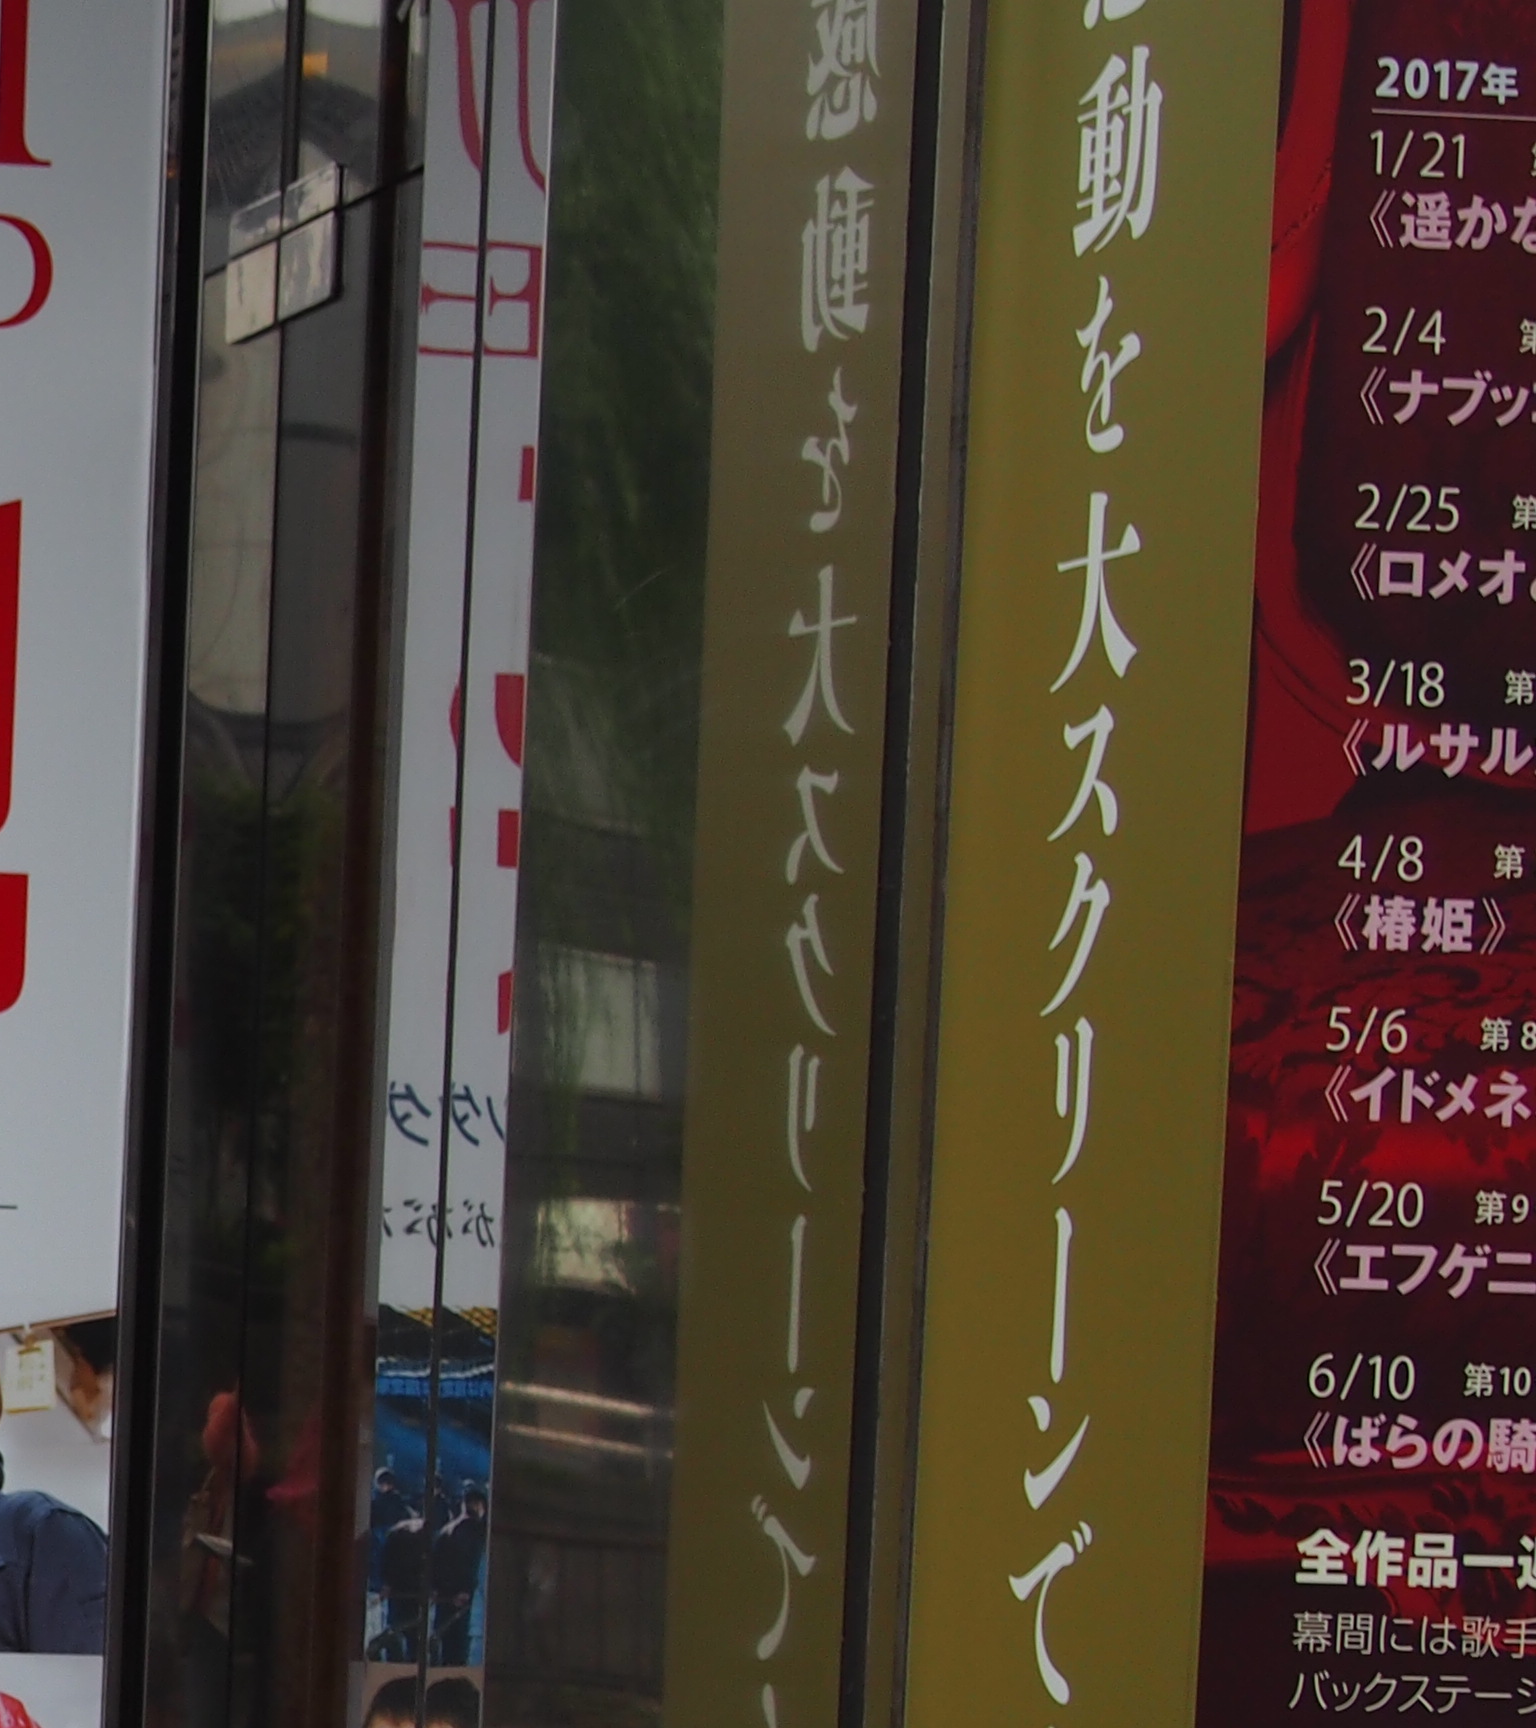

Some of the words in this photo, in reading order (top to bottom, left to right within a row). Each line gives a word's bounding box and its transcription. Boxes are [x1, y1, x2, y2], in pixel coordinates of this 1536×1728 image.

[1375, 56, 1519, 105] 2017年
[1370, 129, 1465, 179] 1/21
[1361, 306, 1446, 355] 2/4
[1360, 366, 1536, 427] 《ナブッ
[1355, 483, 1460, 532] 2/25
[1346, 659, 1445, 707] 3/18
[1338, 834, 1424, 882] 4/8
[1326, 1006, 1408, 1054] 5/6
[1317, 1180, 1424, 1227] 5/20
[1308, 1352, 1415, 1400] 6/10
